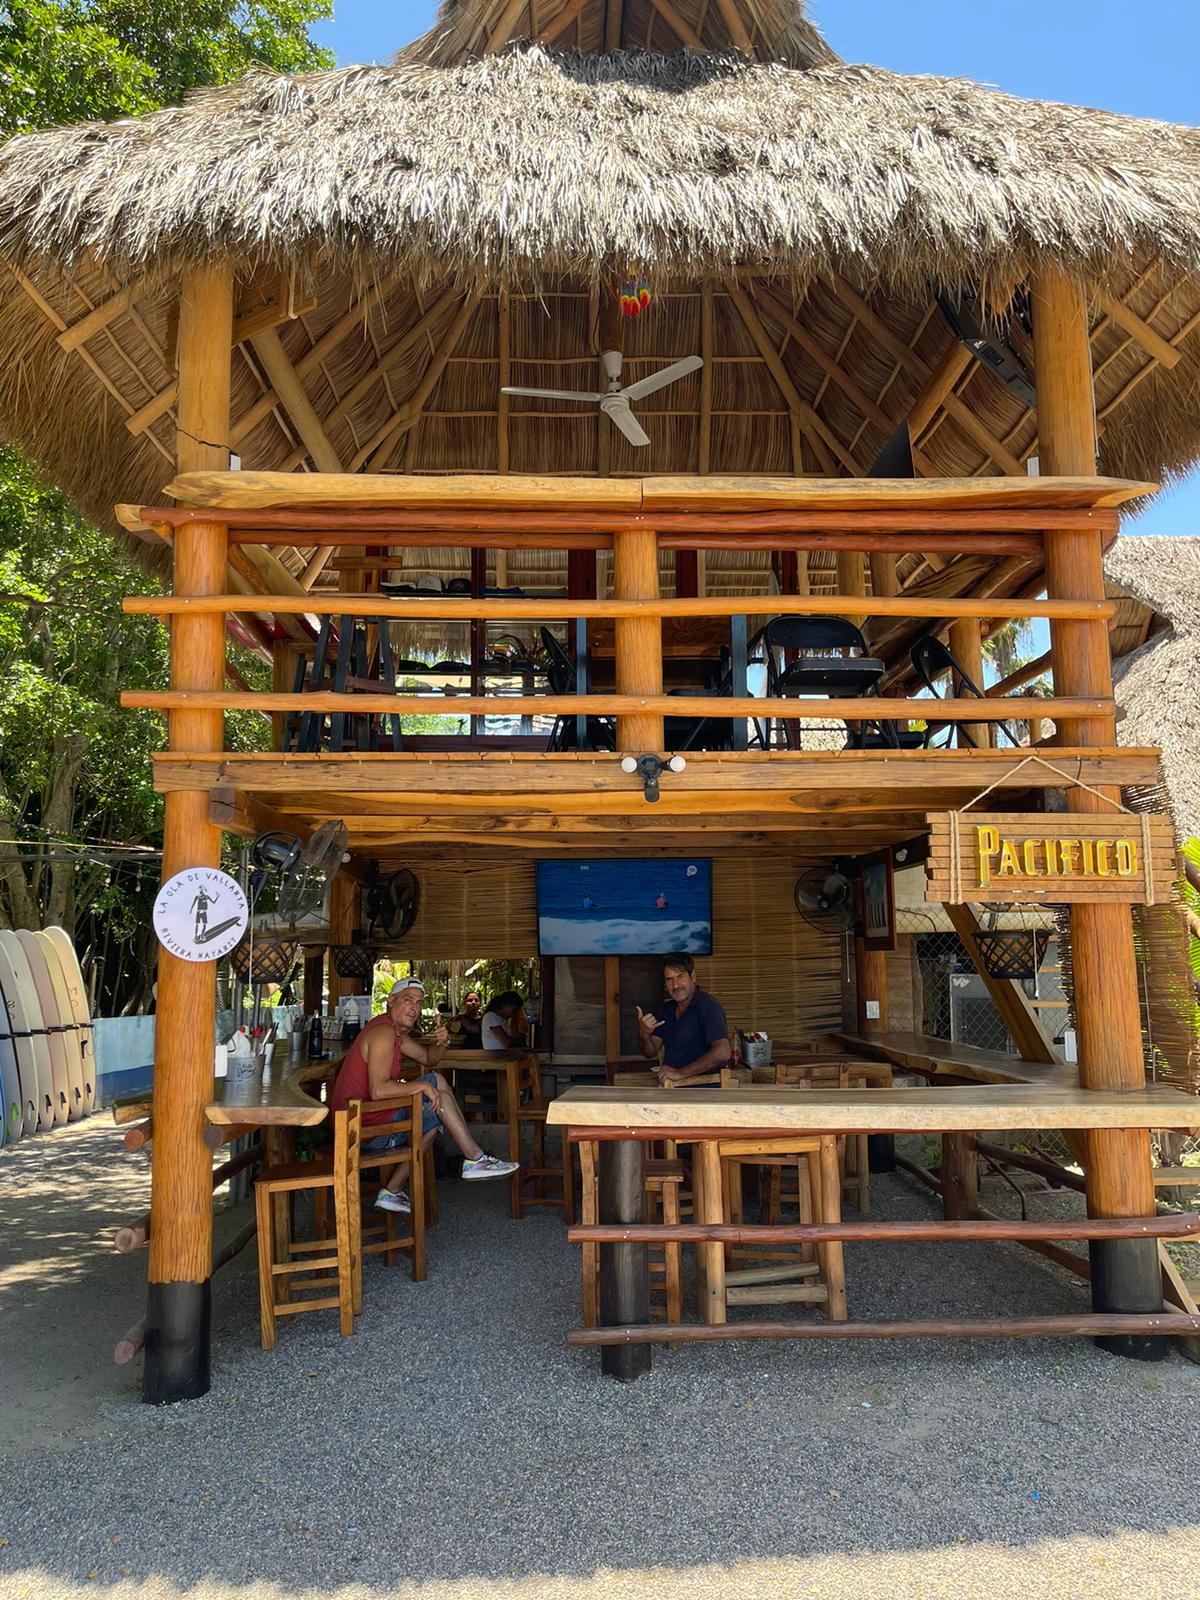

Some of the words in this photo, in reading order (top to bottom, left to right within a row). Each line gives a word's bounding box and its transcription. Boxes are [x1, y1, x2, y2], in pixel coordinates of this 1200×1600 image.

[976, 825, 1138, 888] PACIFICO
[158, 901, 168, 914] LA
[166, 881, 184, 897] OLA
[187, 873, 199, 882] DE
[205, 873, 245, 909] VALLARTA
[160, 927, 192, 959] RIVIERA
